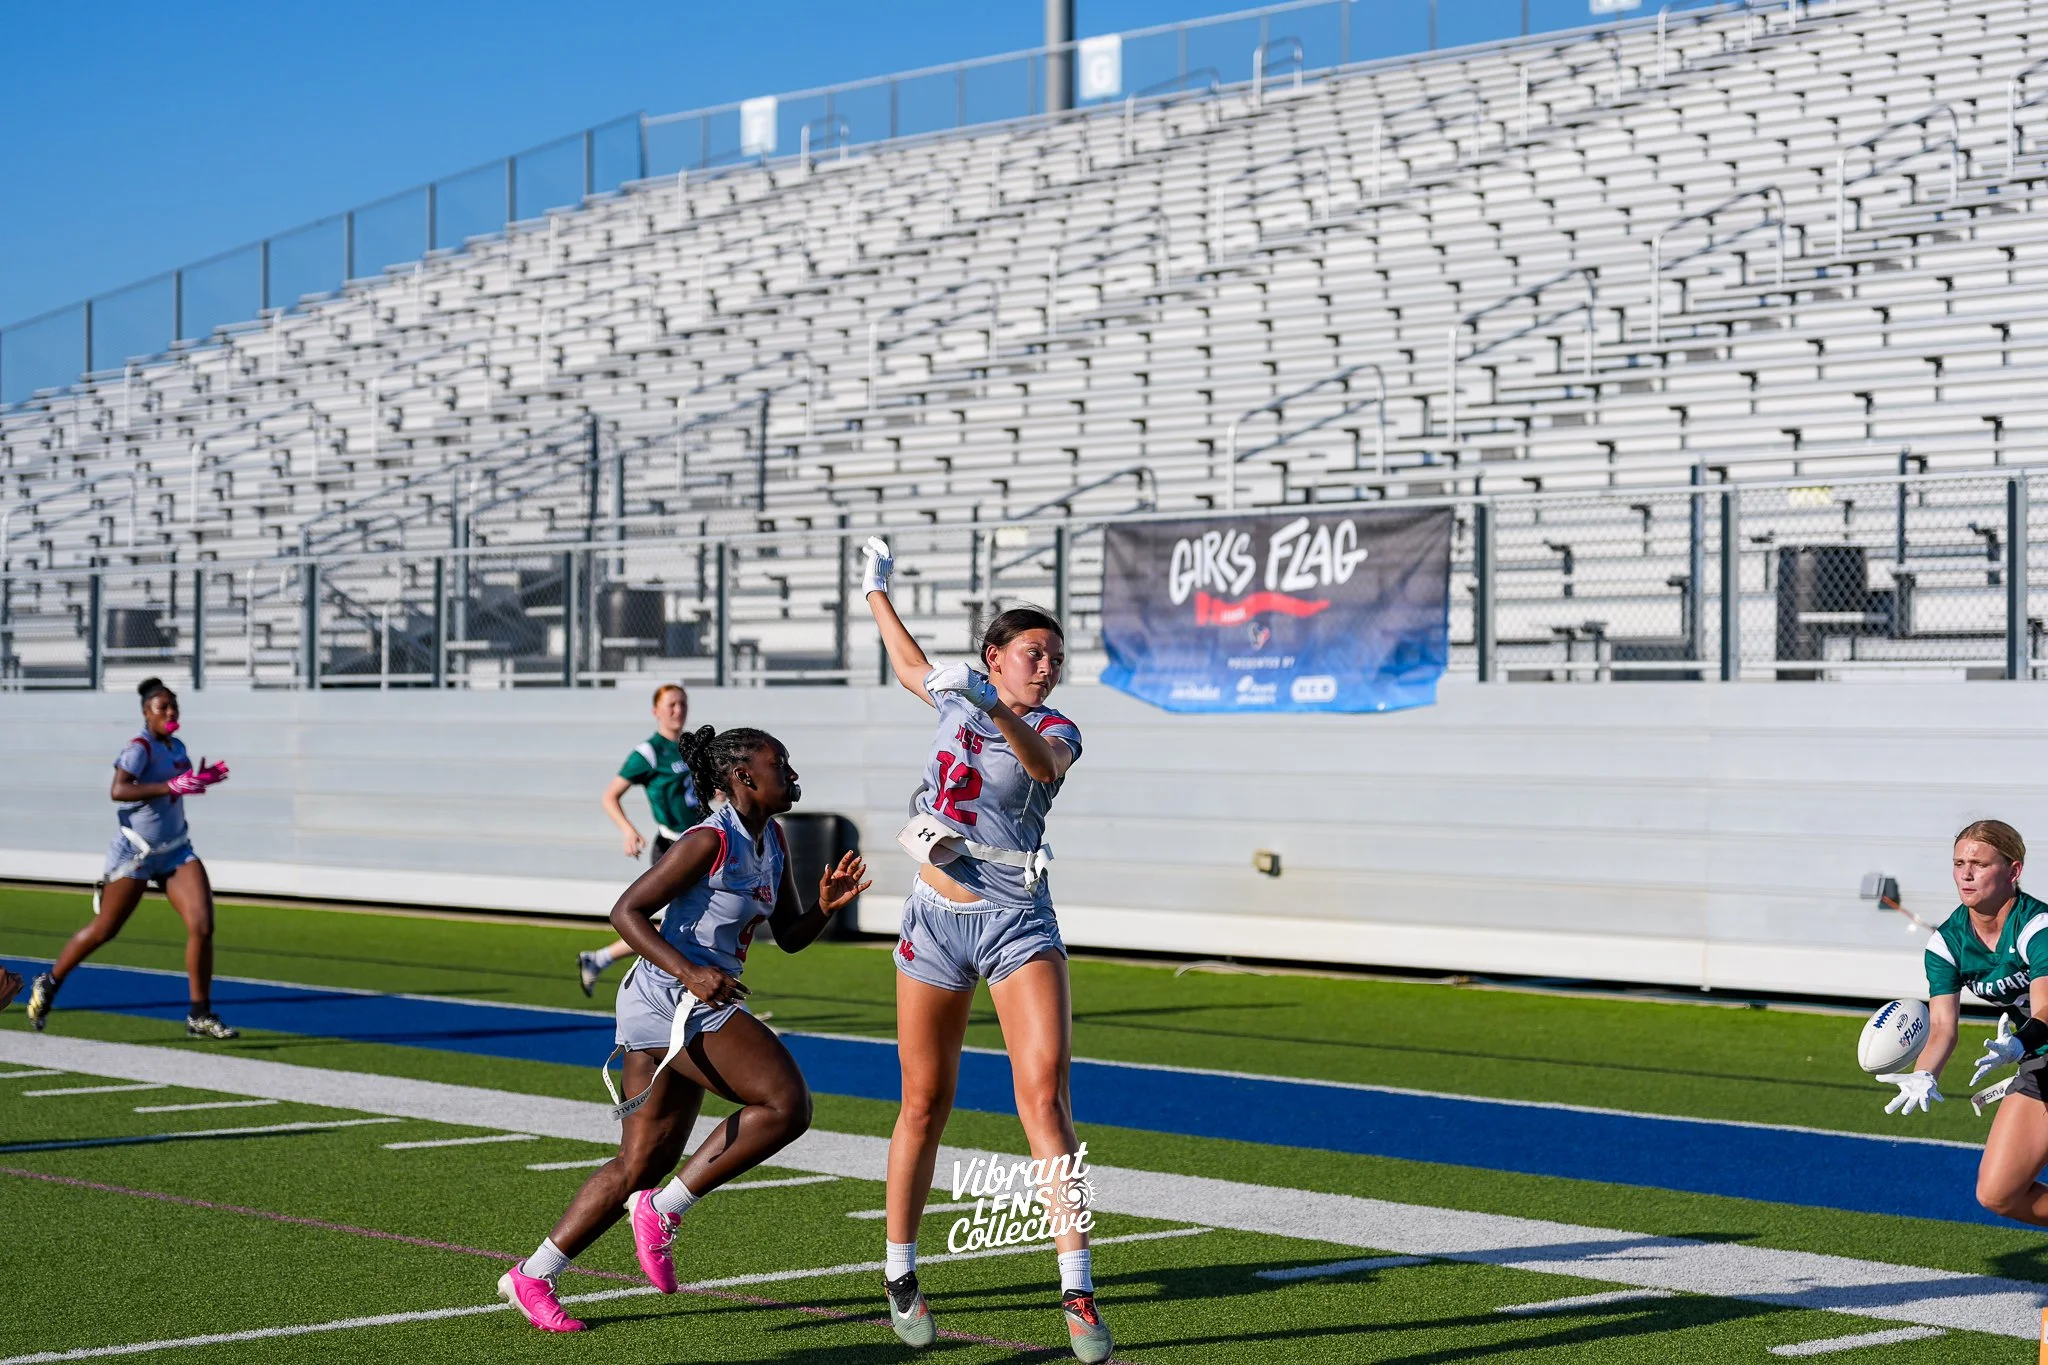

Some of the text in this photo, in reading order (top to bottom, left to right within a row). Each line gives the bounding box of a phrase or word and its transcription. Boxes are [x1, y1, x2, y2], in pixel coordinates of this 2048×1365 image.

[1168, 516, 1369, 606] GIRLS FLAG
[932, 750, 983, 827] 12
[1996, 969, 2031, 996] PAR
[1903, 1017, 1924, 1047] FLAG
